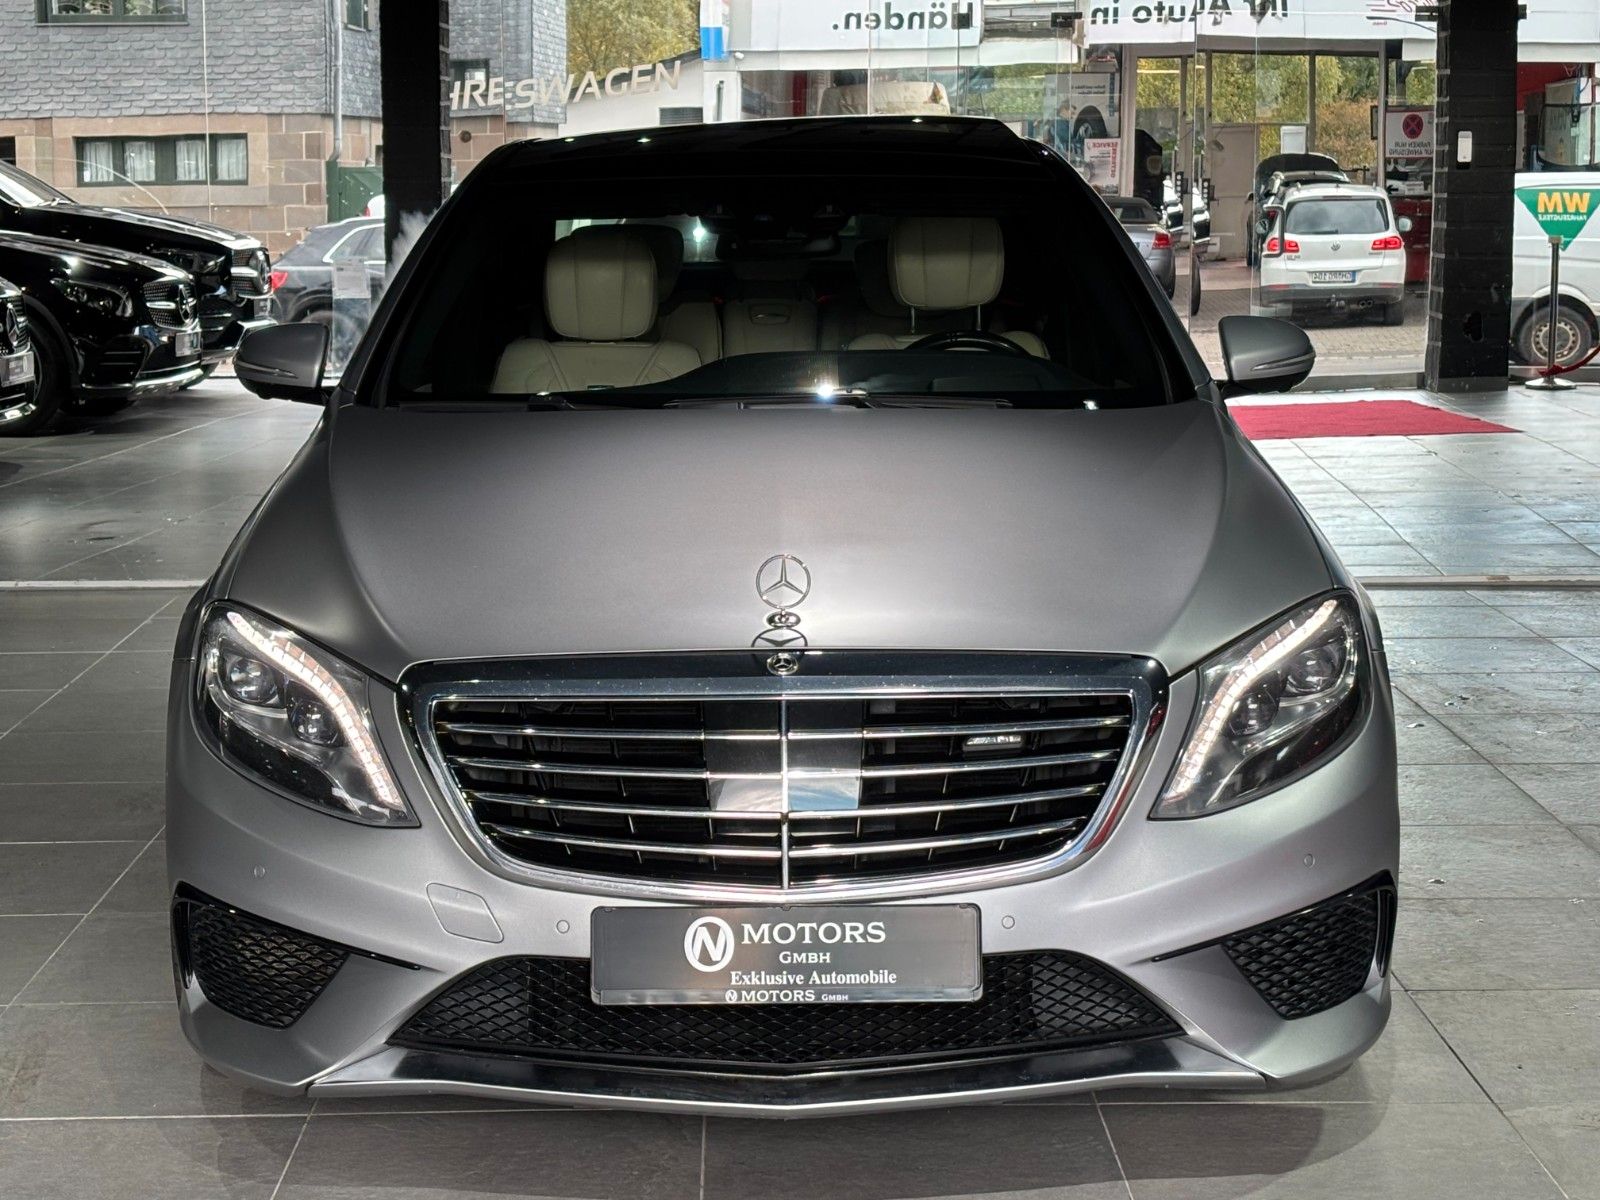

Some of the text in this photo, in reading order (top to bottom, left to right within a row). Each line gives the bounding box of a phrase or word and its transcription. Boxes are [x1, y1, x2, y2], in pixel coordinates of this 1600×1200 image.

[741, 921, 886, 944] MOTORS
[779, 951, 831, 964] GMBH
[730, 969, 897, 985] Exklusive Automobile
[741, 989, 815, 1002] MOTORS
[821, 993, 849, 1001] GMBH
